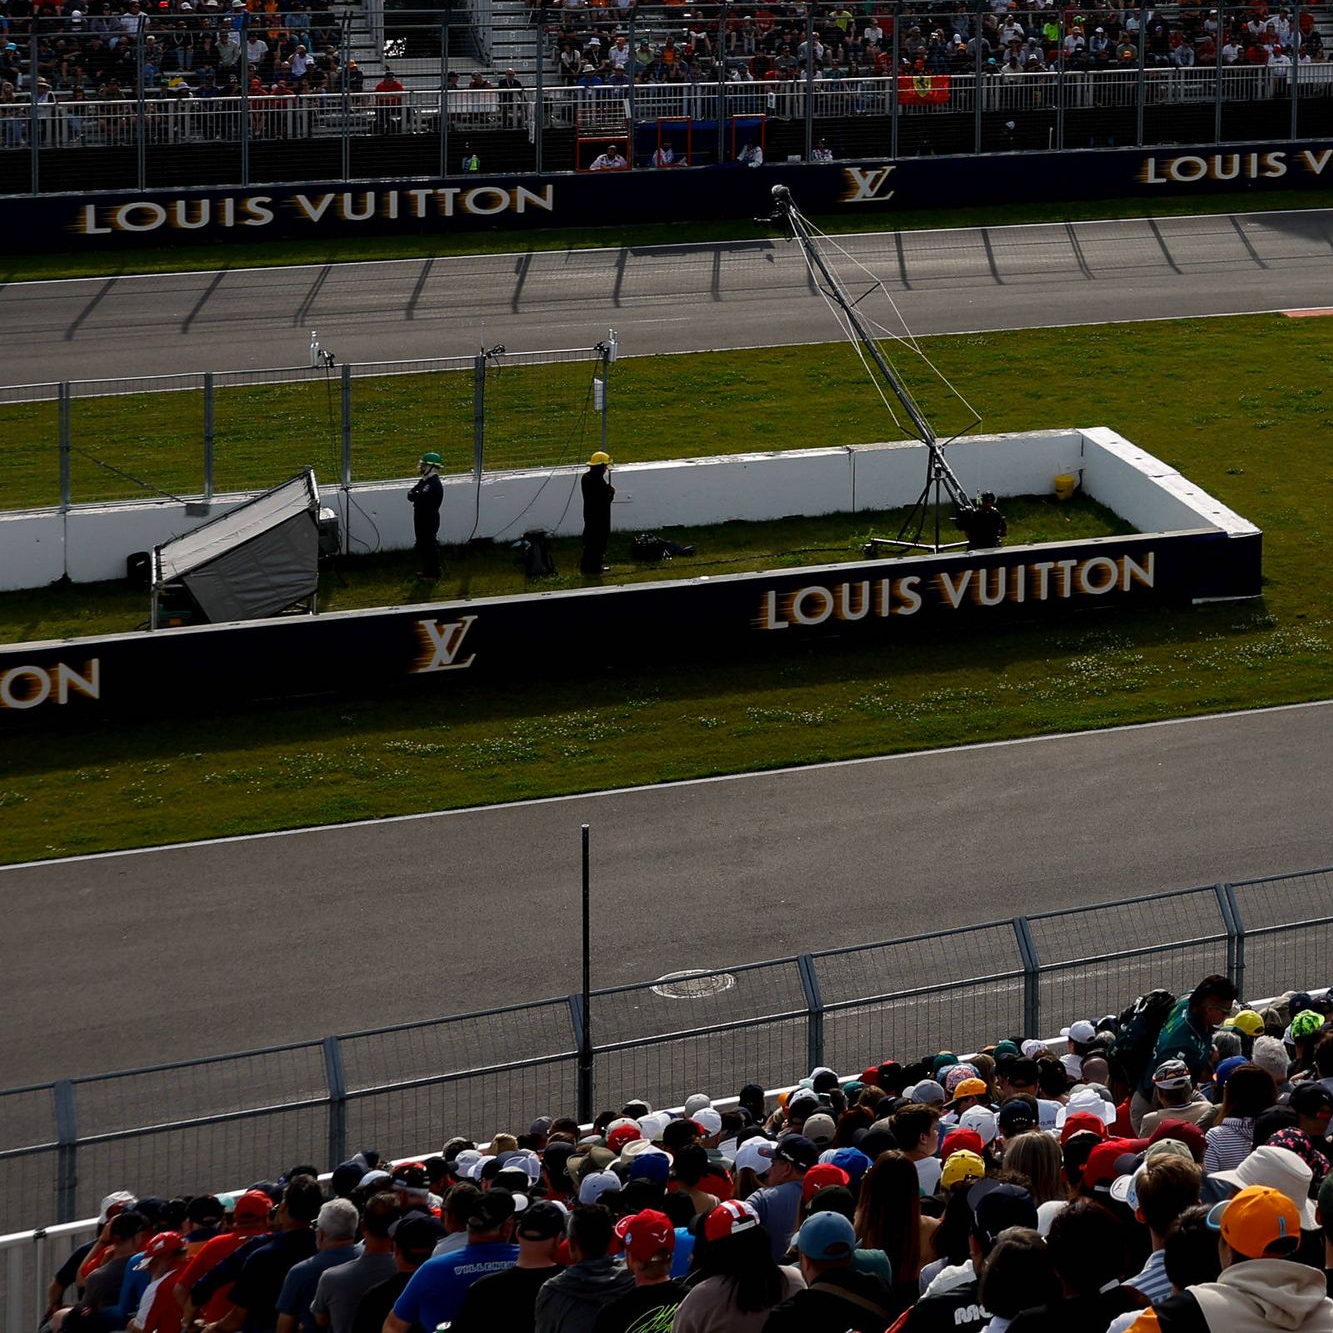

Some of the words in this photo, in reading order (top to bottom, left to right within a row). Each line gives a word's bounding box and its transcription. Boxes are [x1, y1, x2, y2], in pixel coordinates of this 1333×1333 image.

[1146, 152, 1288, 184] LOUIS
[84, 196, 275, 235] LOUIS
[295, 184, 554, 222] VUITTON
[766, 576, 922, 631] LOUIS
[939, 551, 1155, 609] VUITTON
[0, 657, 100, 710] ON
